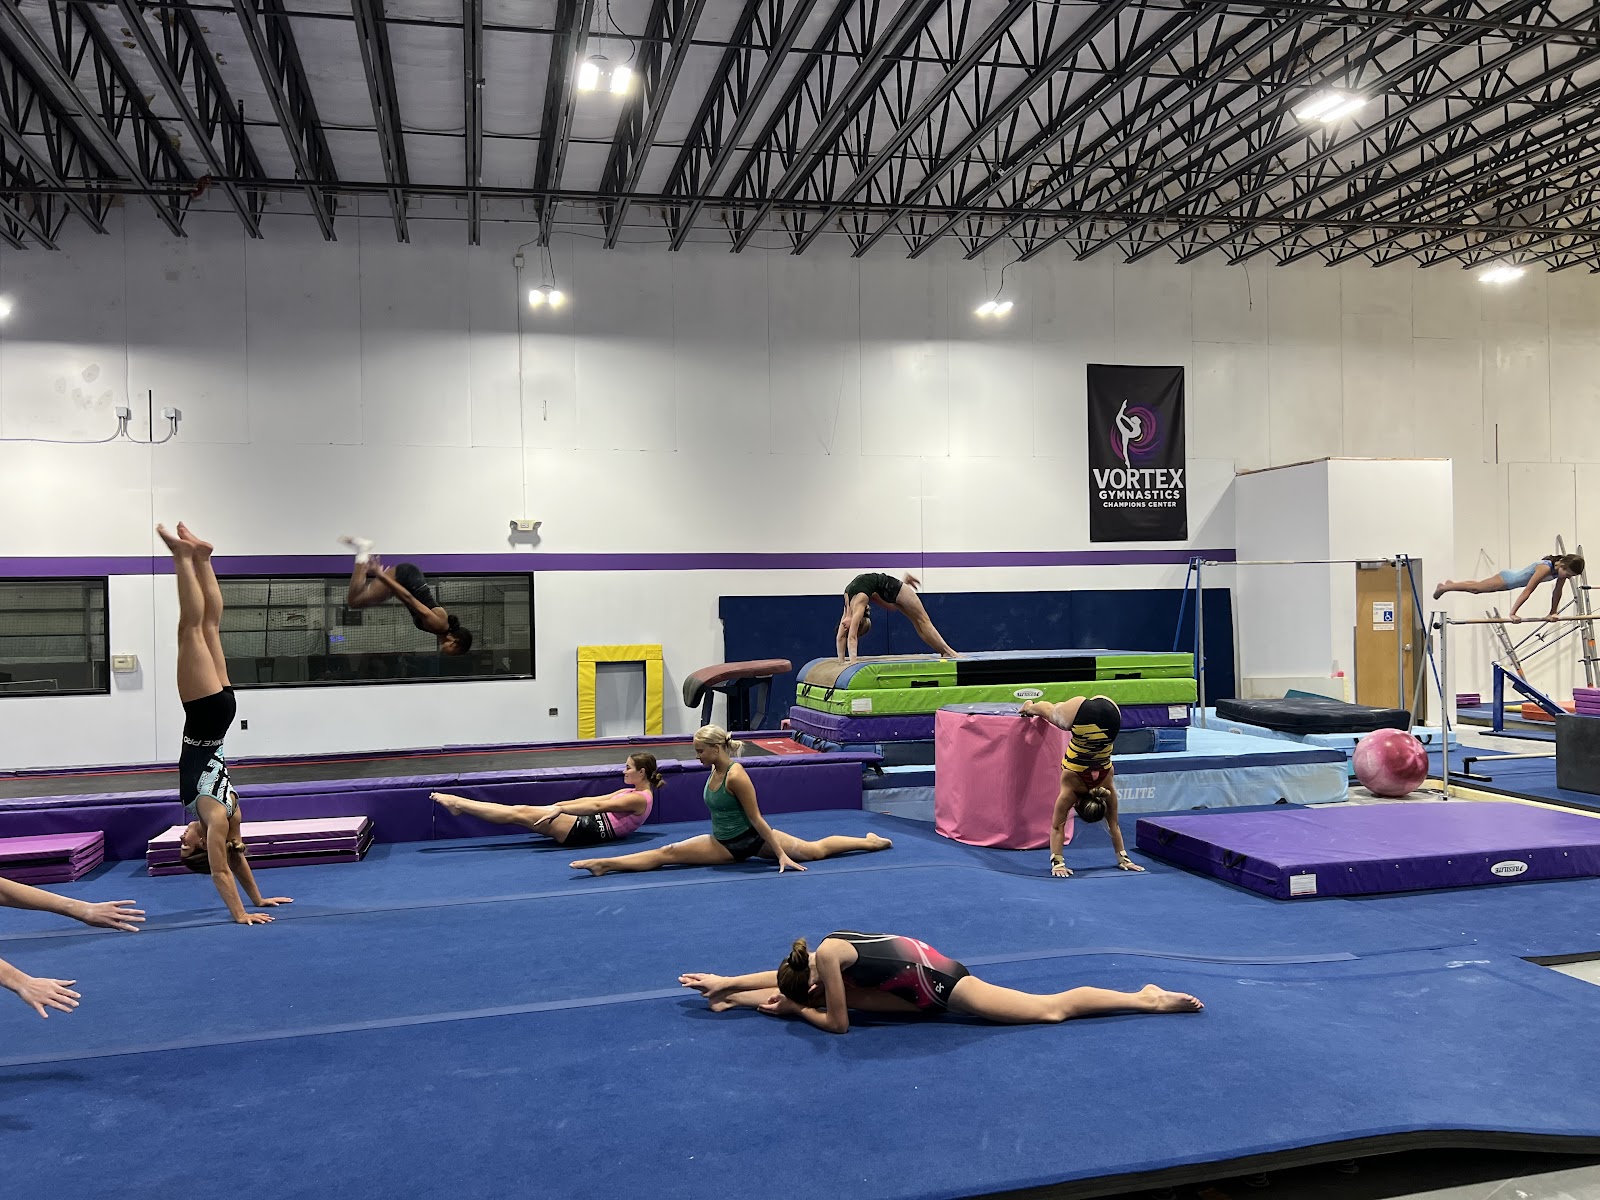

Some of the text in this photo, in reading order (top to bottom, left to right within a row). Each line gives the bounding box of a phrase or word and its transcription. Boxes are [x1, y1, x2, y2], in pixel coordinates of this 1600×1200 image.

[1092, 468, 1184, 489] VORTEX
[1099, 490, 1180, 500] GYMNASTICS
[183, 735, 202, 747] PRO
[1116, 787, 1155, 800] SILITE
[596, 820, 606, 838] PRO
[1494, 865, 1520, 874] RESILITE
